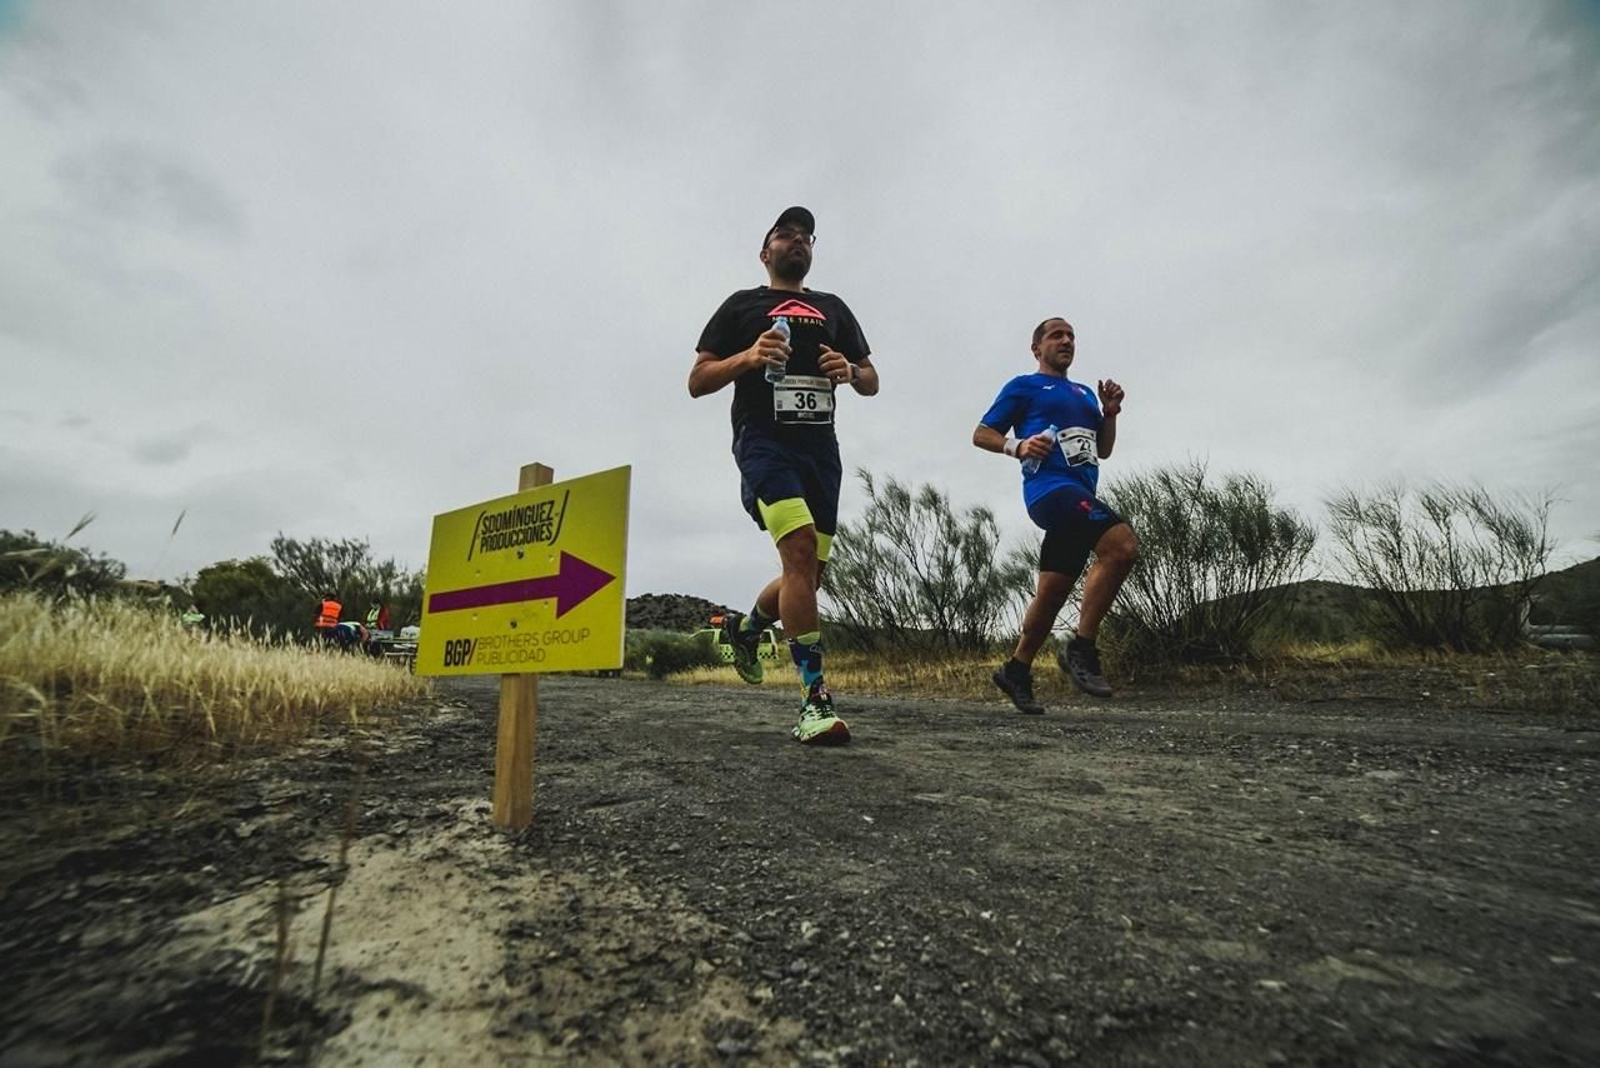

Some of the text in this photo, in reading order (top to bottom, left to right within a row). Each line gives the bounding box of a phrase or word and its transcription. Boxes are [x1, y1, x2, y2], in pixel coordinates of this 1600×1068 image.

[799, 317, 824, 327] TRAIL
[795, 392, 817, 410] 36
[481, 500, 555, 535] SDOMÍNGUEZ
[480, 523, 554, 553] PRODUCCIONES
[477, 628, 590, 650] BROTHERS GROUP
[477, 649, 546, 666] PUBLICIDAD
